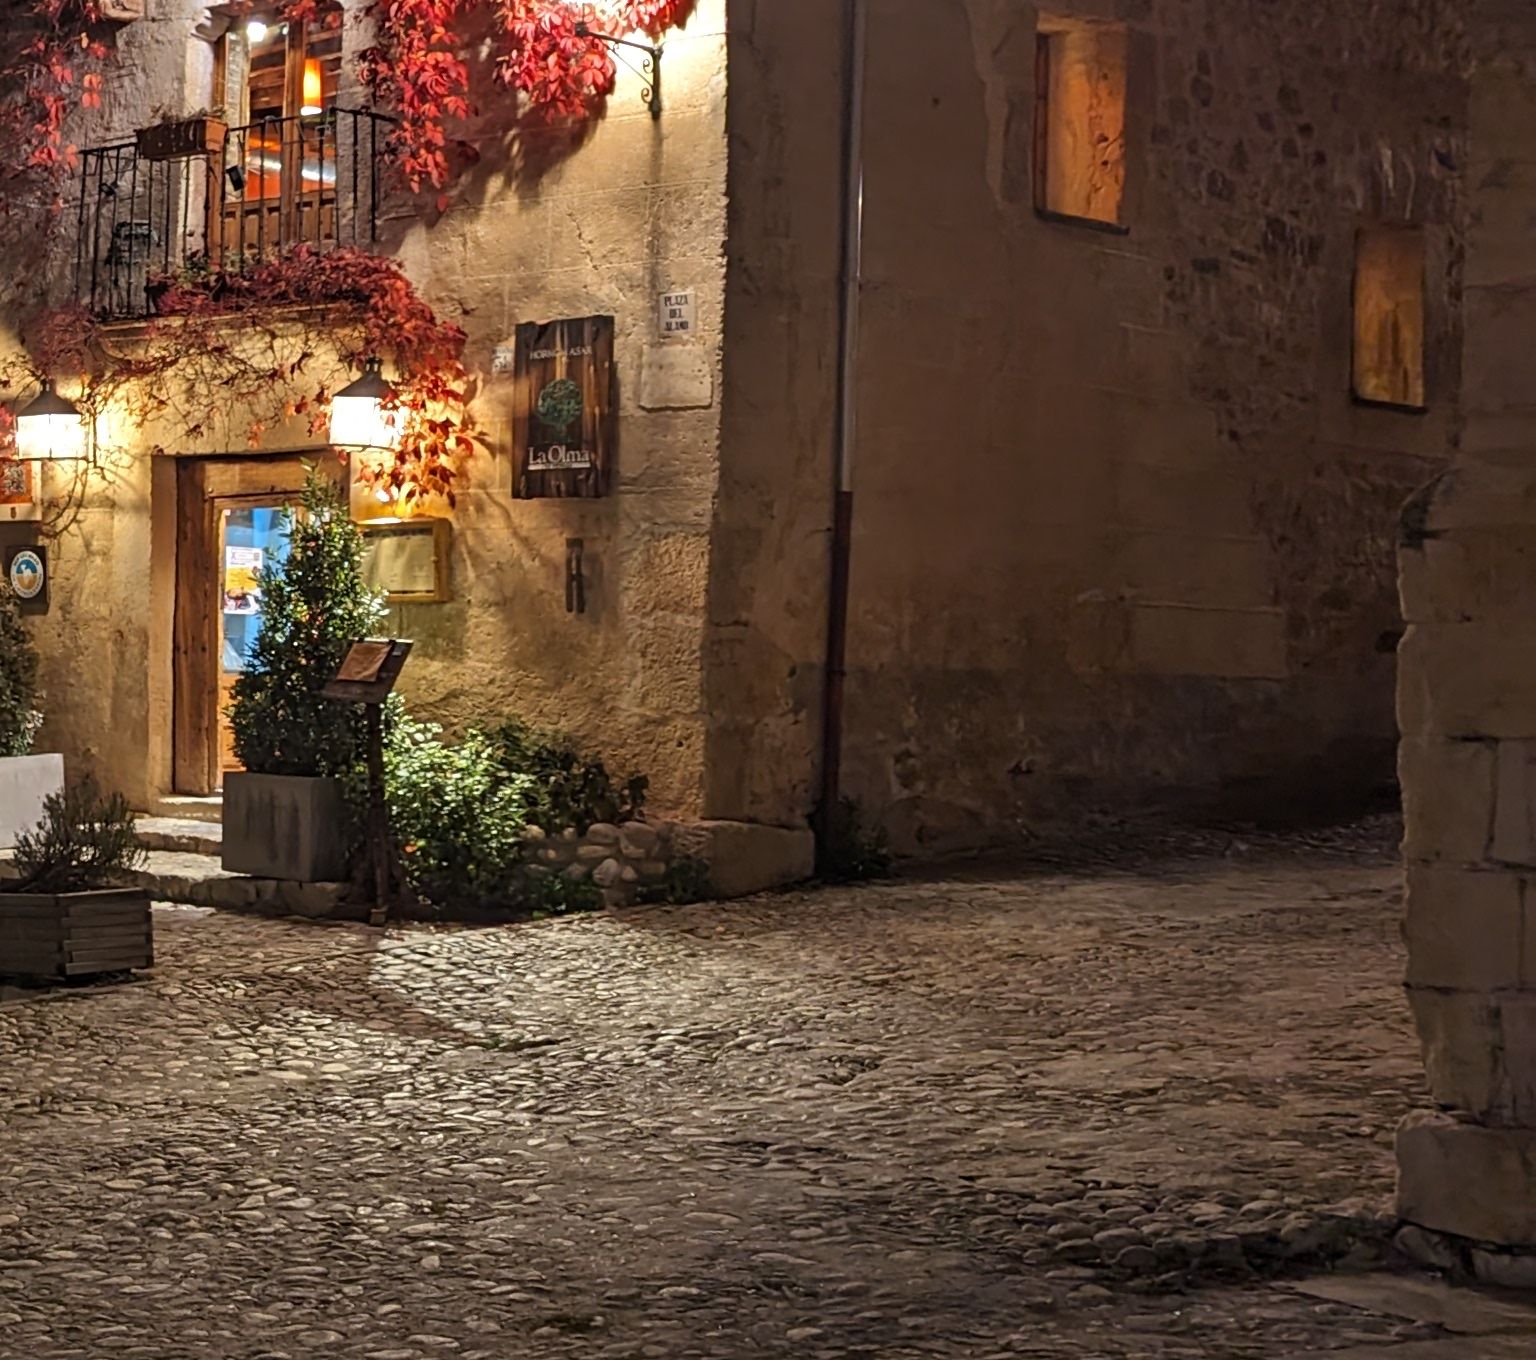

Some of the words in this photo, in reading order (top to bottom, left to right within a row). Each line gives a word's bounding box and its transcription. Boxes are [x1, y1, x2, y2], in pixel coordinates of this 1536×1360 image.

[664, 295, 689, 306] PLAZA
[528, 447, 547, 464] La
[548, 445, 590, 463] Olma
